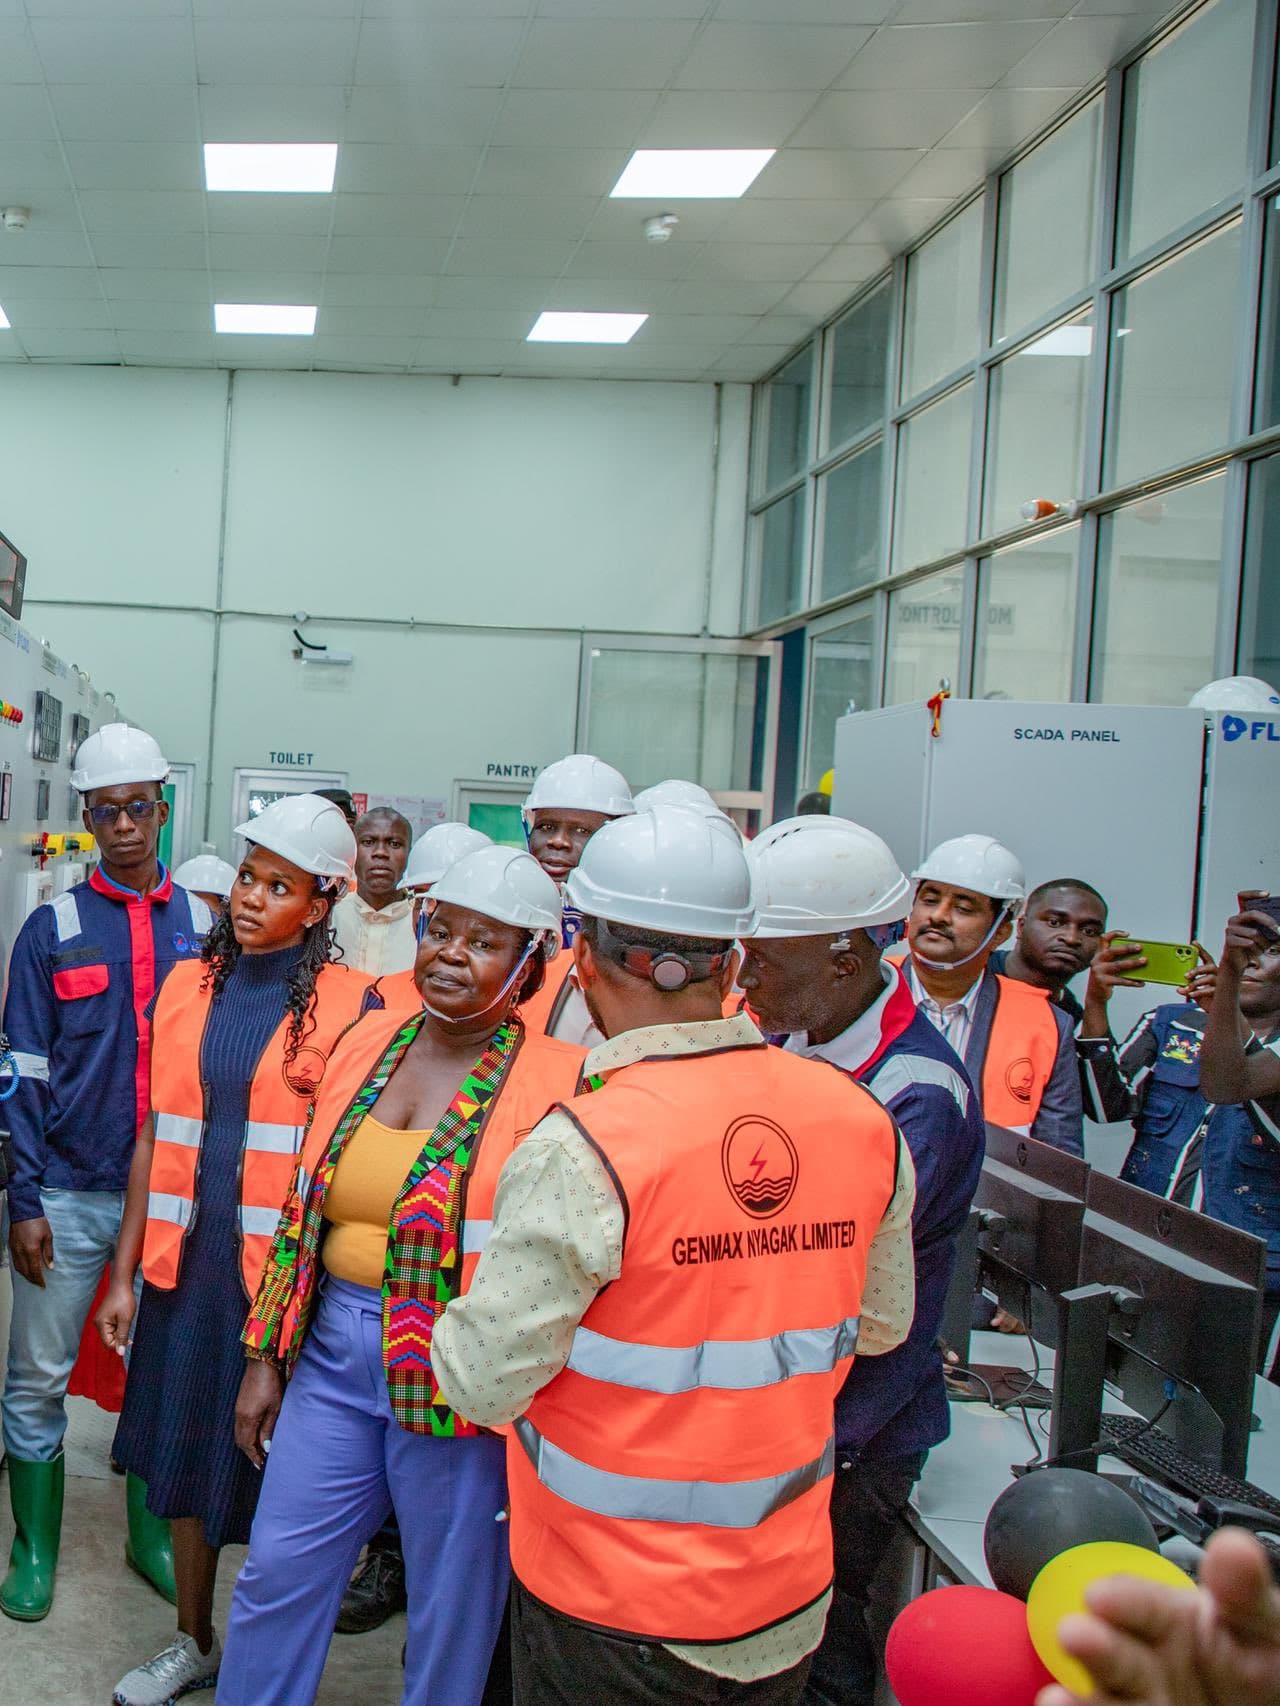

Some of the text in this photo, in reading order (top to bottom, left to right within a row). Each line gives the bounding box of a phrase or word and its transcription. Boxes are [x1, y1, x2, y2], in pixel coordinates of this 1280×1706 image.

[1013, 728, 1120, 742] SCADA PANEL
[269, 752, 314, 766] TOILET
[486, 764, 538, 778] PANTRY
[672, 1219, 856, 1266] GENMAX NYAGAK LIMITED
